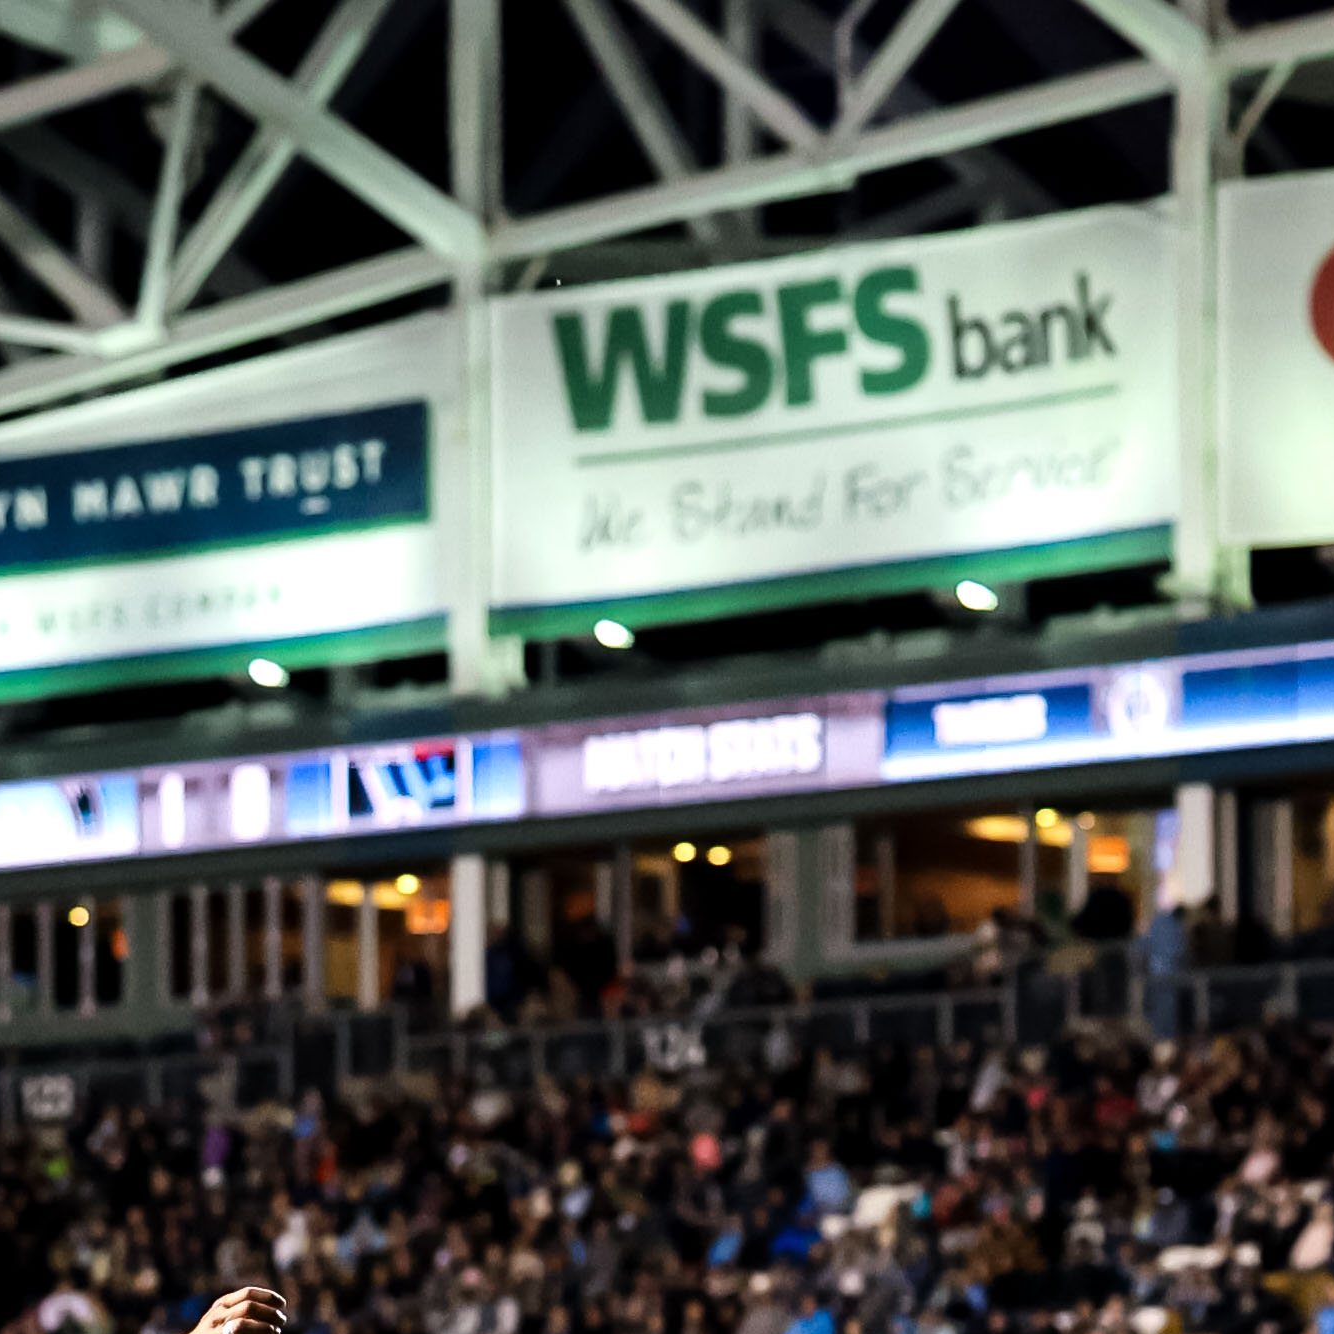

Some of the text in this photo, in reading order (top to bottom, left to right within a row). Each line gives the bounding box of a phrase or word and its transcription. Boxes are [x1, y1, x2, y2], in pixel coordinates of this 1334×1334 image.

[553, 265, 1117, 433] WSFS bank
[73, 463, 219, 521] MAWR
[240, 440, 386, 499] TRUST
[843, 463, 929, 520] For
